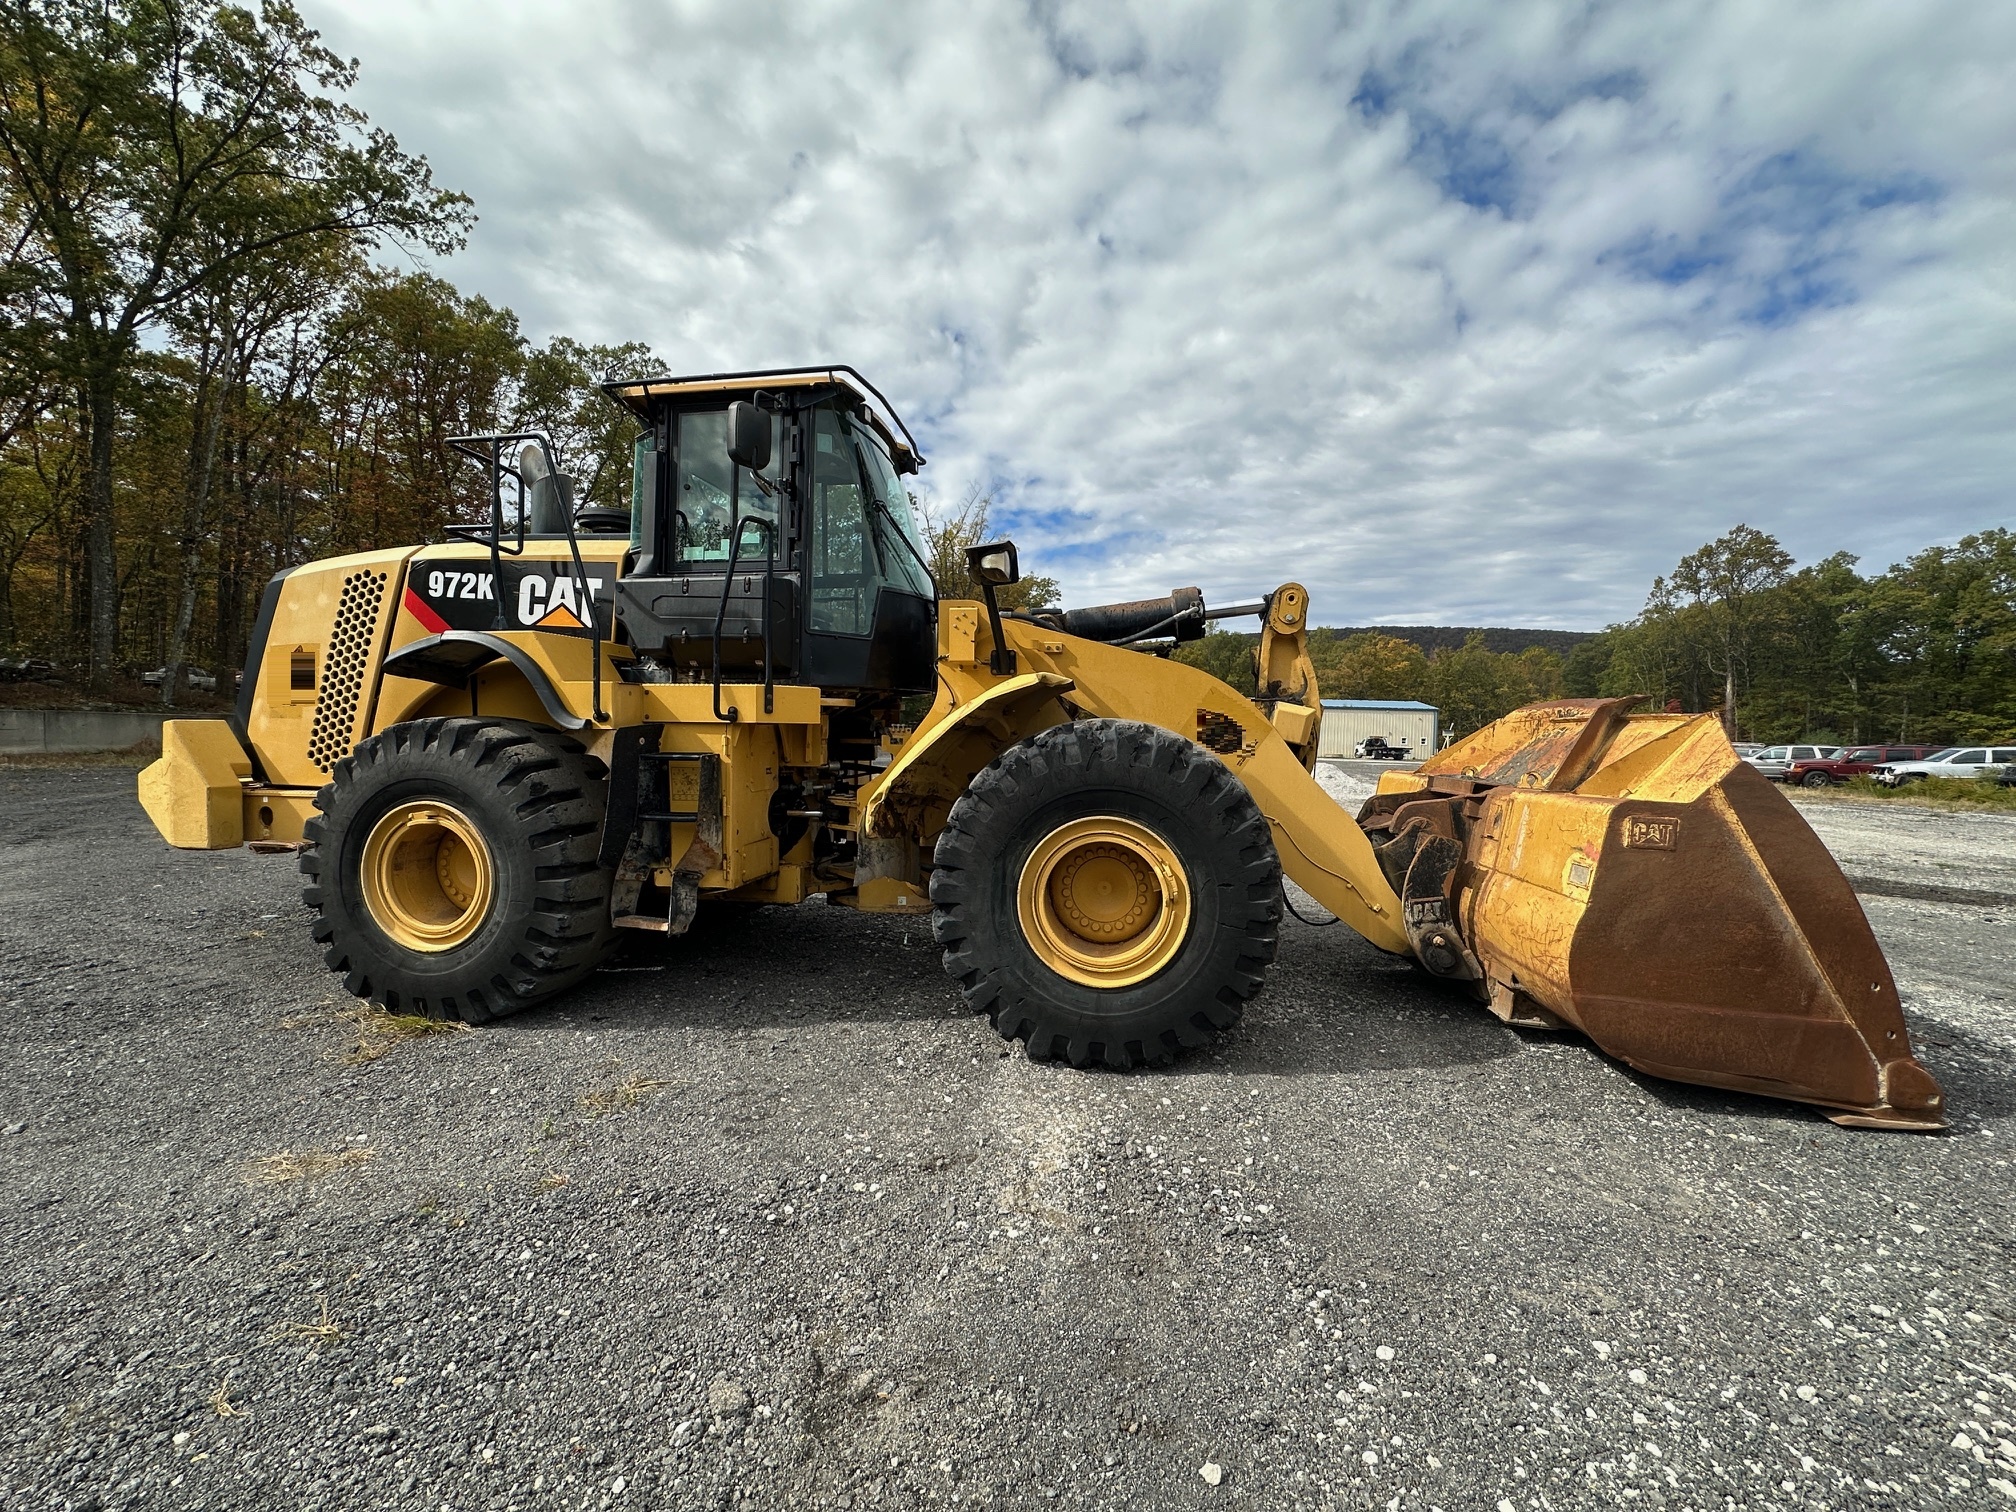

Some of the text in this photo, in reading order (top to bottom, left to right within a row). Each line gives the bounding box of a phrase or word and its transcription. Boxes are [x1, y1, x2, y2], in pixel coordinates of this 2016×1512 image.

[429, 571, 493, 599] 972K
[518, 574, 602, 628] CAT
[1633, 822, 1673, 846] CAT
[1413, 902, 1442, 922] CAT
